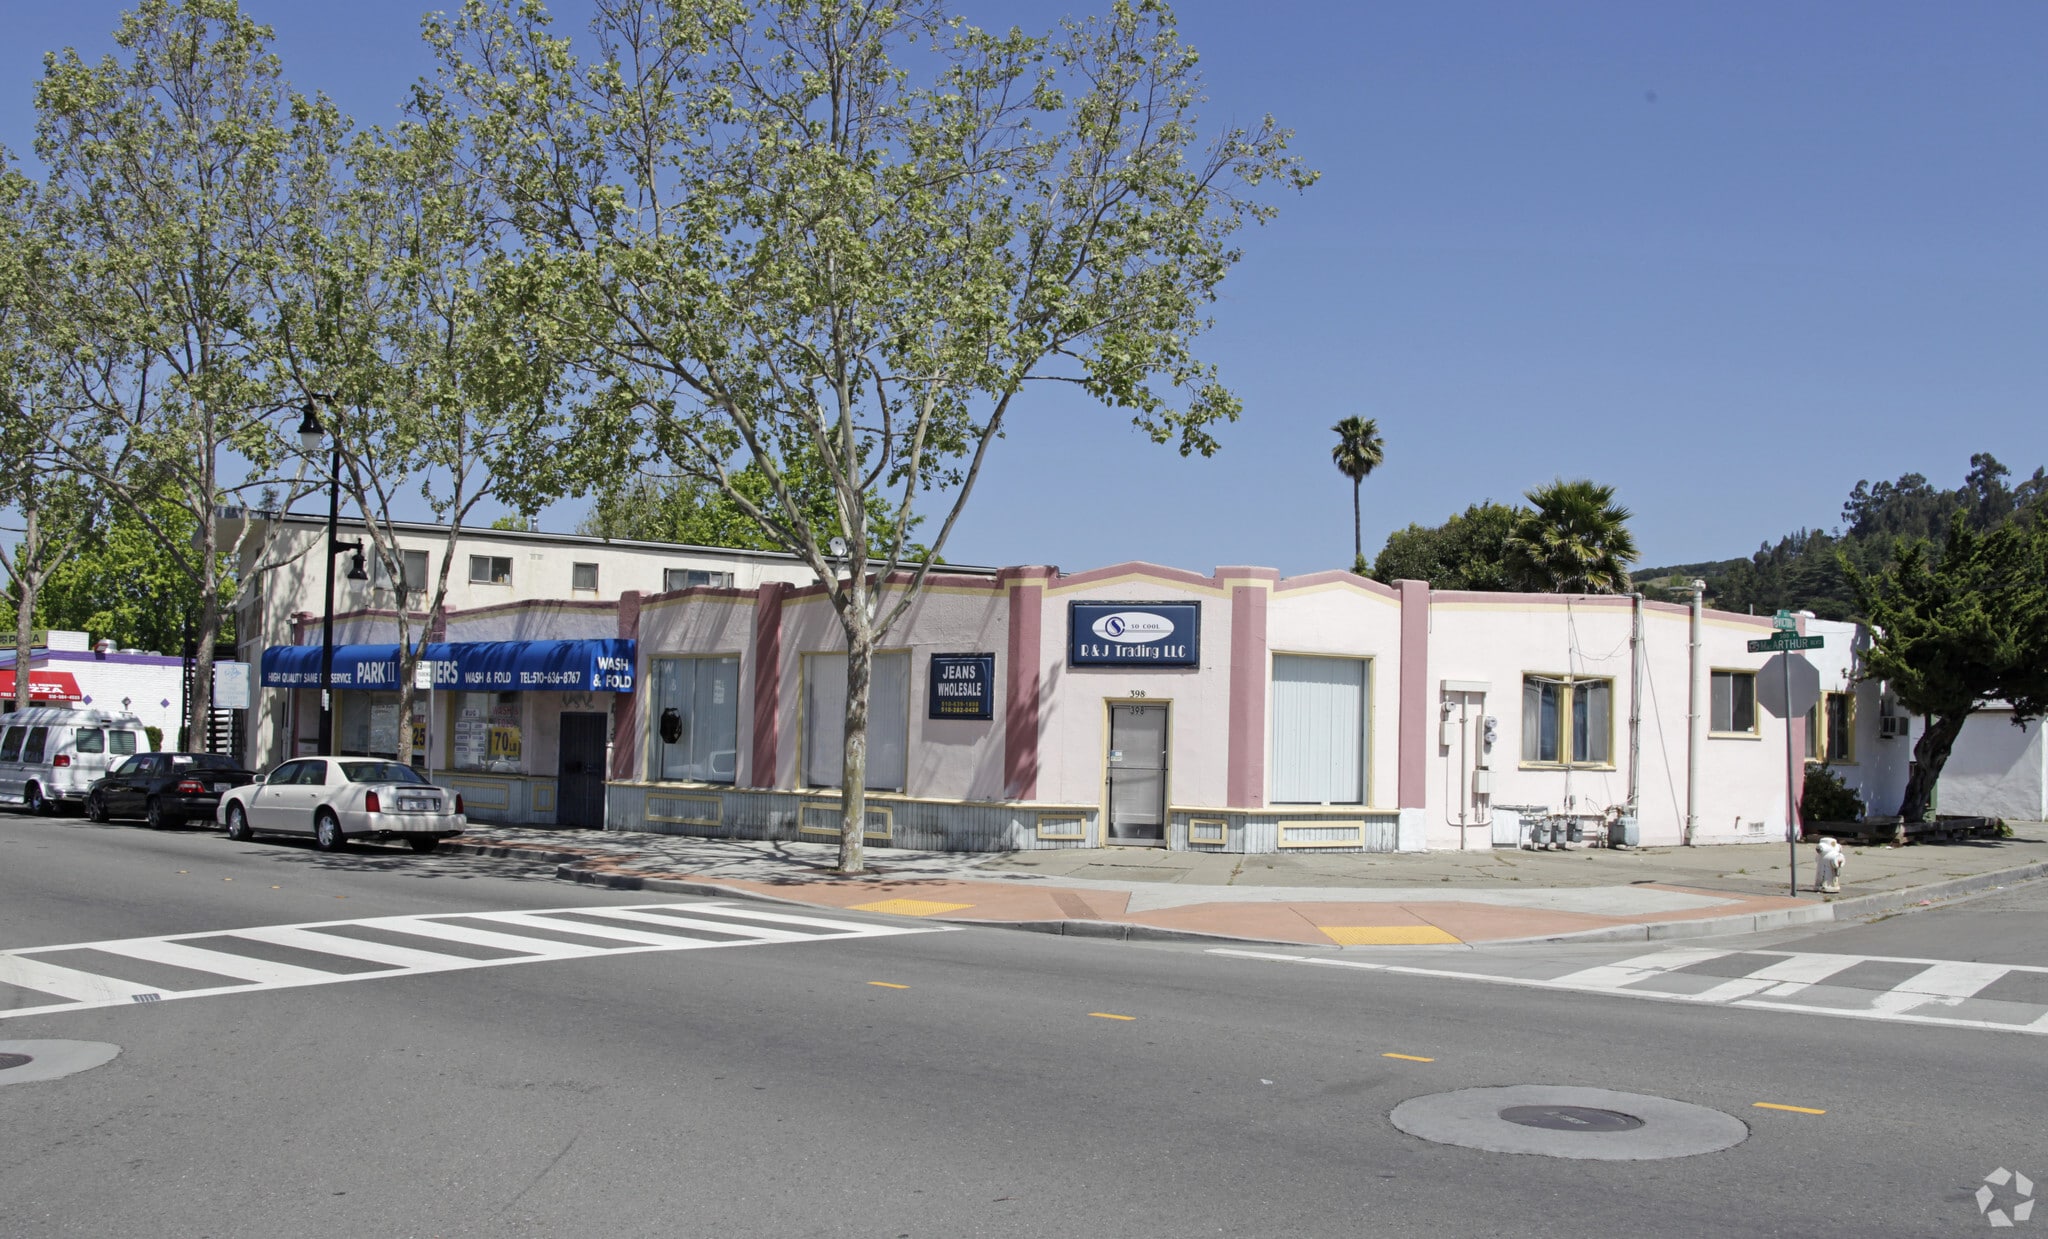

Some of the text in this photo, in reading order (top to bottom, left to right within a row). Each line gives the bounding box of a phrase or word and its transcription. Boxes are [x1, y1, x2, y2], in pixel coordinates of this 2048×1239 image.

[1115, 644, 1159, 659] Trading
[1164, 645, 1186, 658] LLC
[597, 657, 629, 671] WASH
[268, 673, 281, 682] HIGH
[282, 673, 302, 683] QUALITY
[304, 673, 318, 683] SAME
[331, 673, 352, 684] SERVICE
[357, 661, 386, 684] PARK
[465, 672, 511, 683] WASH & FOLD
[942, 665, 976, 679] JEANS
[593, 674, 632, 688] & FOLD
[938, 682, 982, 696] WHOLESALE
[1130, 690, 1146, 698] 398
[1130, 706, 1144, 715] 398
[495, 732, 509, 751] 70
